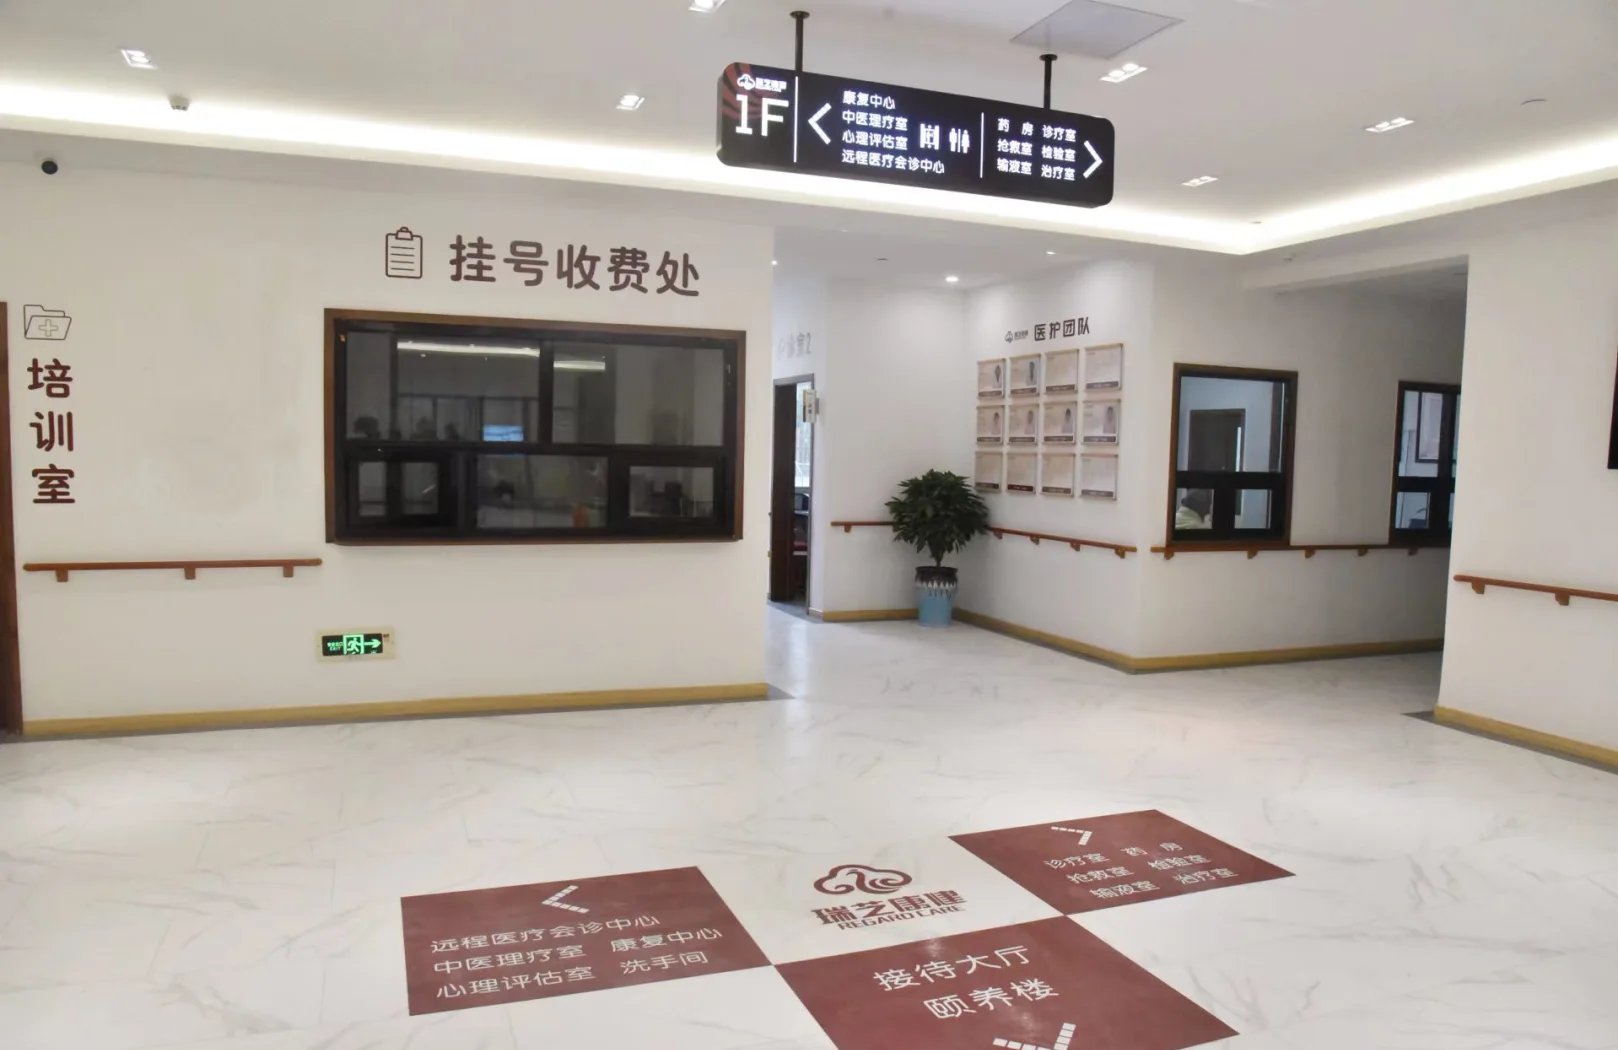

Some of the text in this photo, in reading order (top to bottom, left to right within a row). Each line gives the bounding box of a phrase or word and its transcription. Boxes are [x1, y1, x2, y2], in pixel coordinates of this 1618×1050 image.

[842, 90, 896, 110] 康复中心
[736, 94, 789, 136] 1F
[842, 110, 908, 131] 中医理疗室
[842, 130, 908, 150] 心理评估室
[1042, 124, 1077, 143] 诊疗室
[842, 149, 945, 174] 远程医疗会诊中心
[997, 139, 1076, 163] 抢救室 检验室
[997, 158, 1076, 181] 输液室 治疗室
[449, 234, 700, 297] 挂号收费处
[1034, 317, 1090, 341] 医护团队
[27, 358, 75, 504] 培训室
[1043, 853, 1110, 869] 诊疗室
[1172, 867, 1239, 885] 治疗室
[838, 905, 965, 930] REGARD CARE
[431, 914, 660, 954] 远程医疗会诊中心
[434, 927, 723, 975] 中医理疗室 康复中心
[437, 950, 708, 999] 心理评估室 洗手间
[873, 945, 1031, 991] 接待大厅
[923, 978, 1060, 1019] 颐养楼
